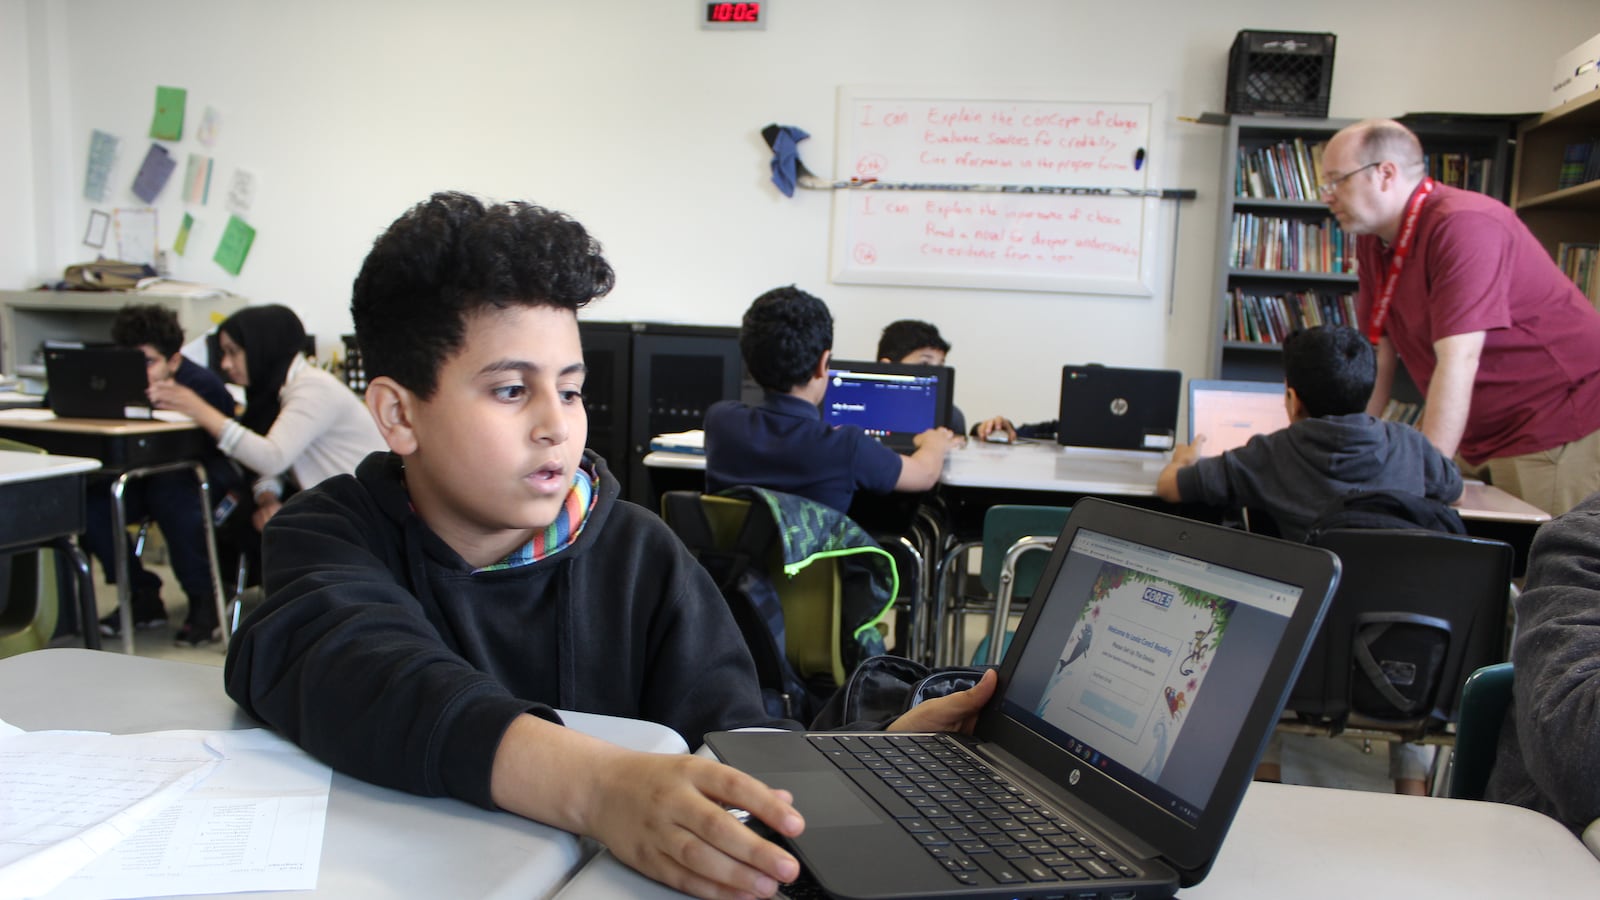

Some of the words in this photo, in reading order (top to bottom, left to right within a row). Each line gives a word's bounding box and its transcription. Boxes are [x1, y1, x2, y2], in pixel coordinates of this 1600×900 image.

[882, 111, 909, 128] can
[927, 106, 982, 128] Explain
[1022, 112, 1081, 129] concept
[1001, 185, 1112, 196] EASTON
